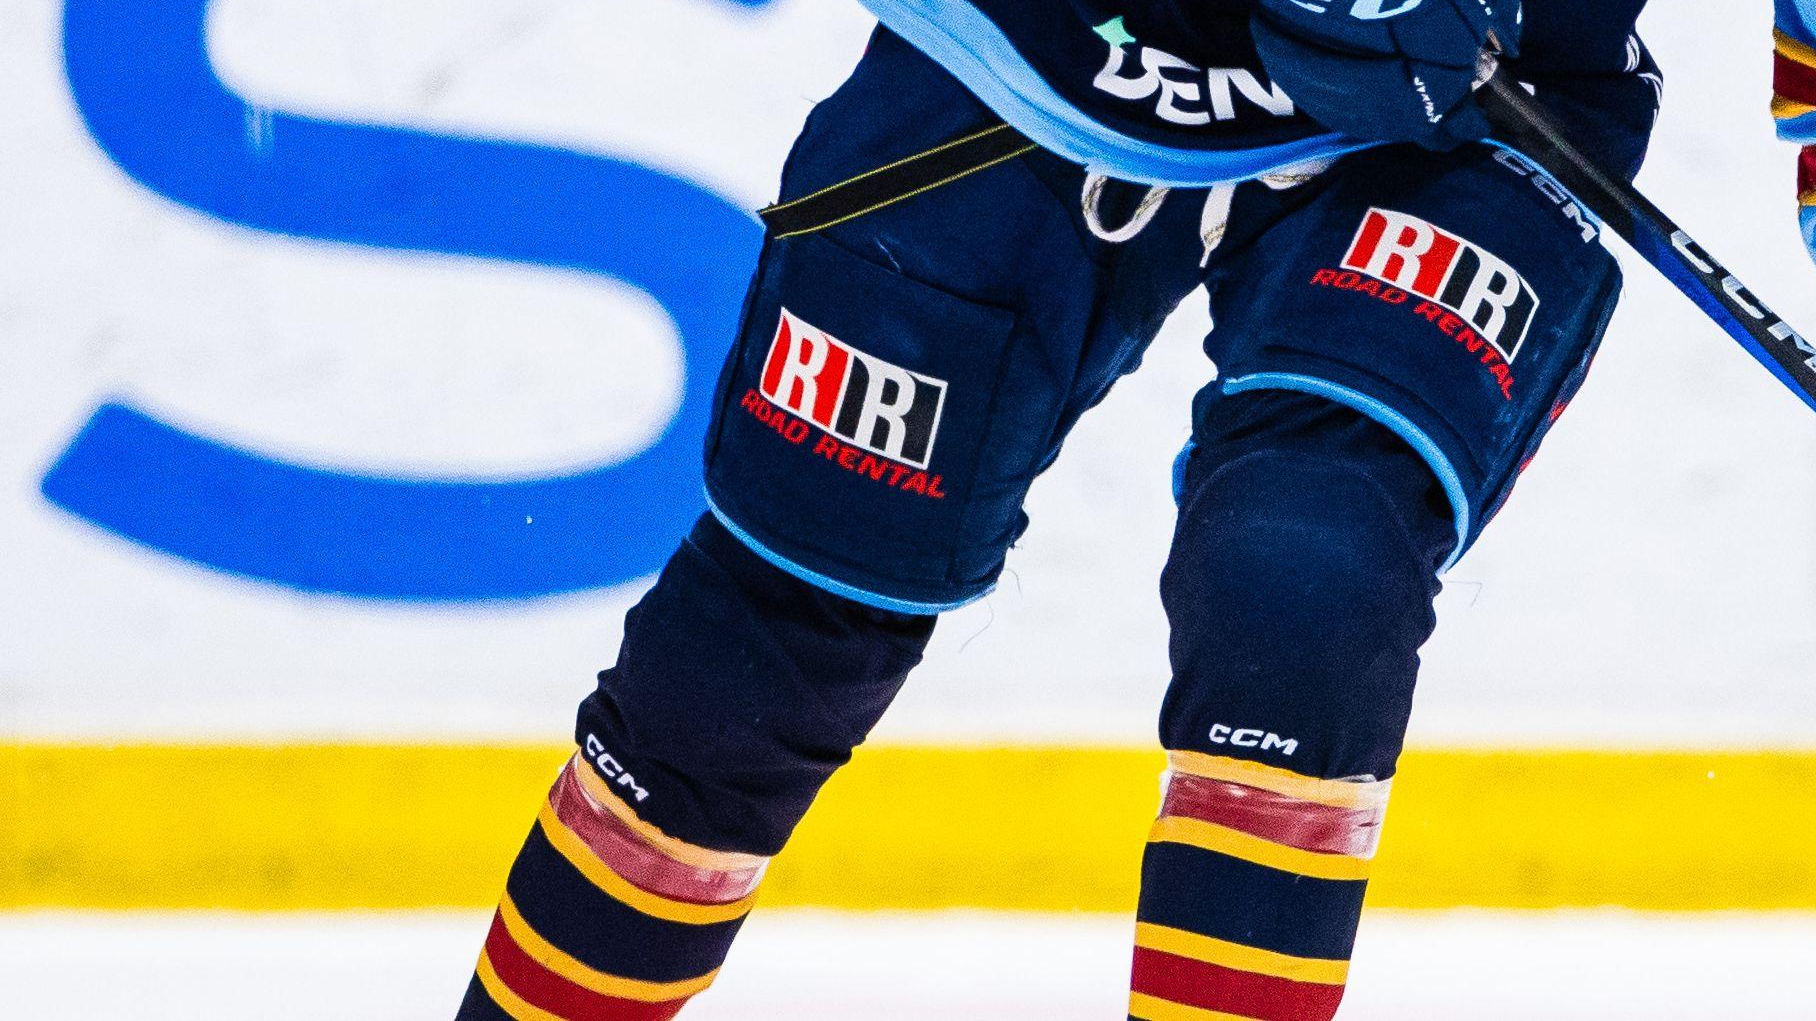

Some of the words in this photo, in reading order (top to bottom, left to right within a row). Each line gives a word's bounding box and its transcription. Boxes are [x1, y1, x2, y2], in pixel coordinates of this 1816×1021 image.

[1491, 149, 1599, 244] CCM
[1309, 267, 1408, 305] ROAD
[1413, 300, 1514, 401] RENTAL
[739, 388, 811, 445] ROAD
[812, 433, 946, 500] RENTAL
[586, 733, 650, 803] CCM
[1207, 723, 1299, 756] CCM
